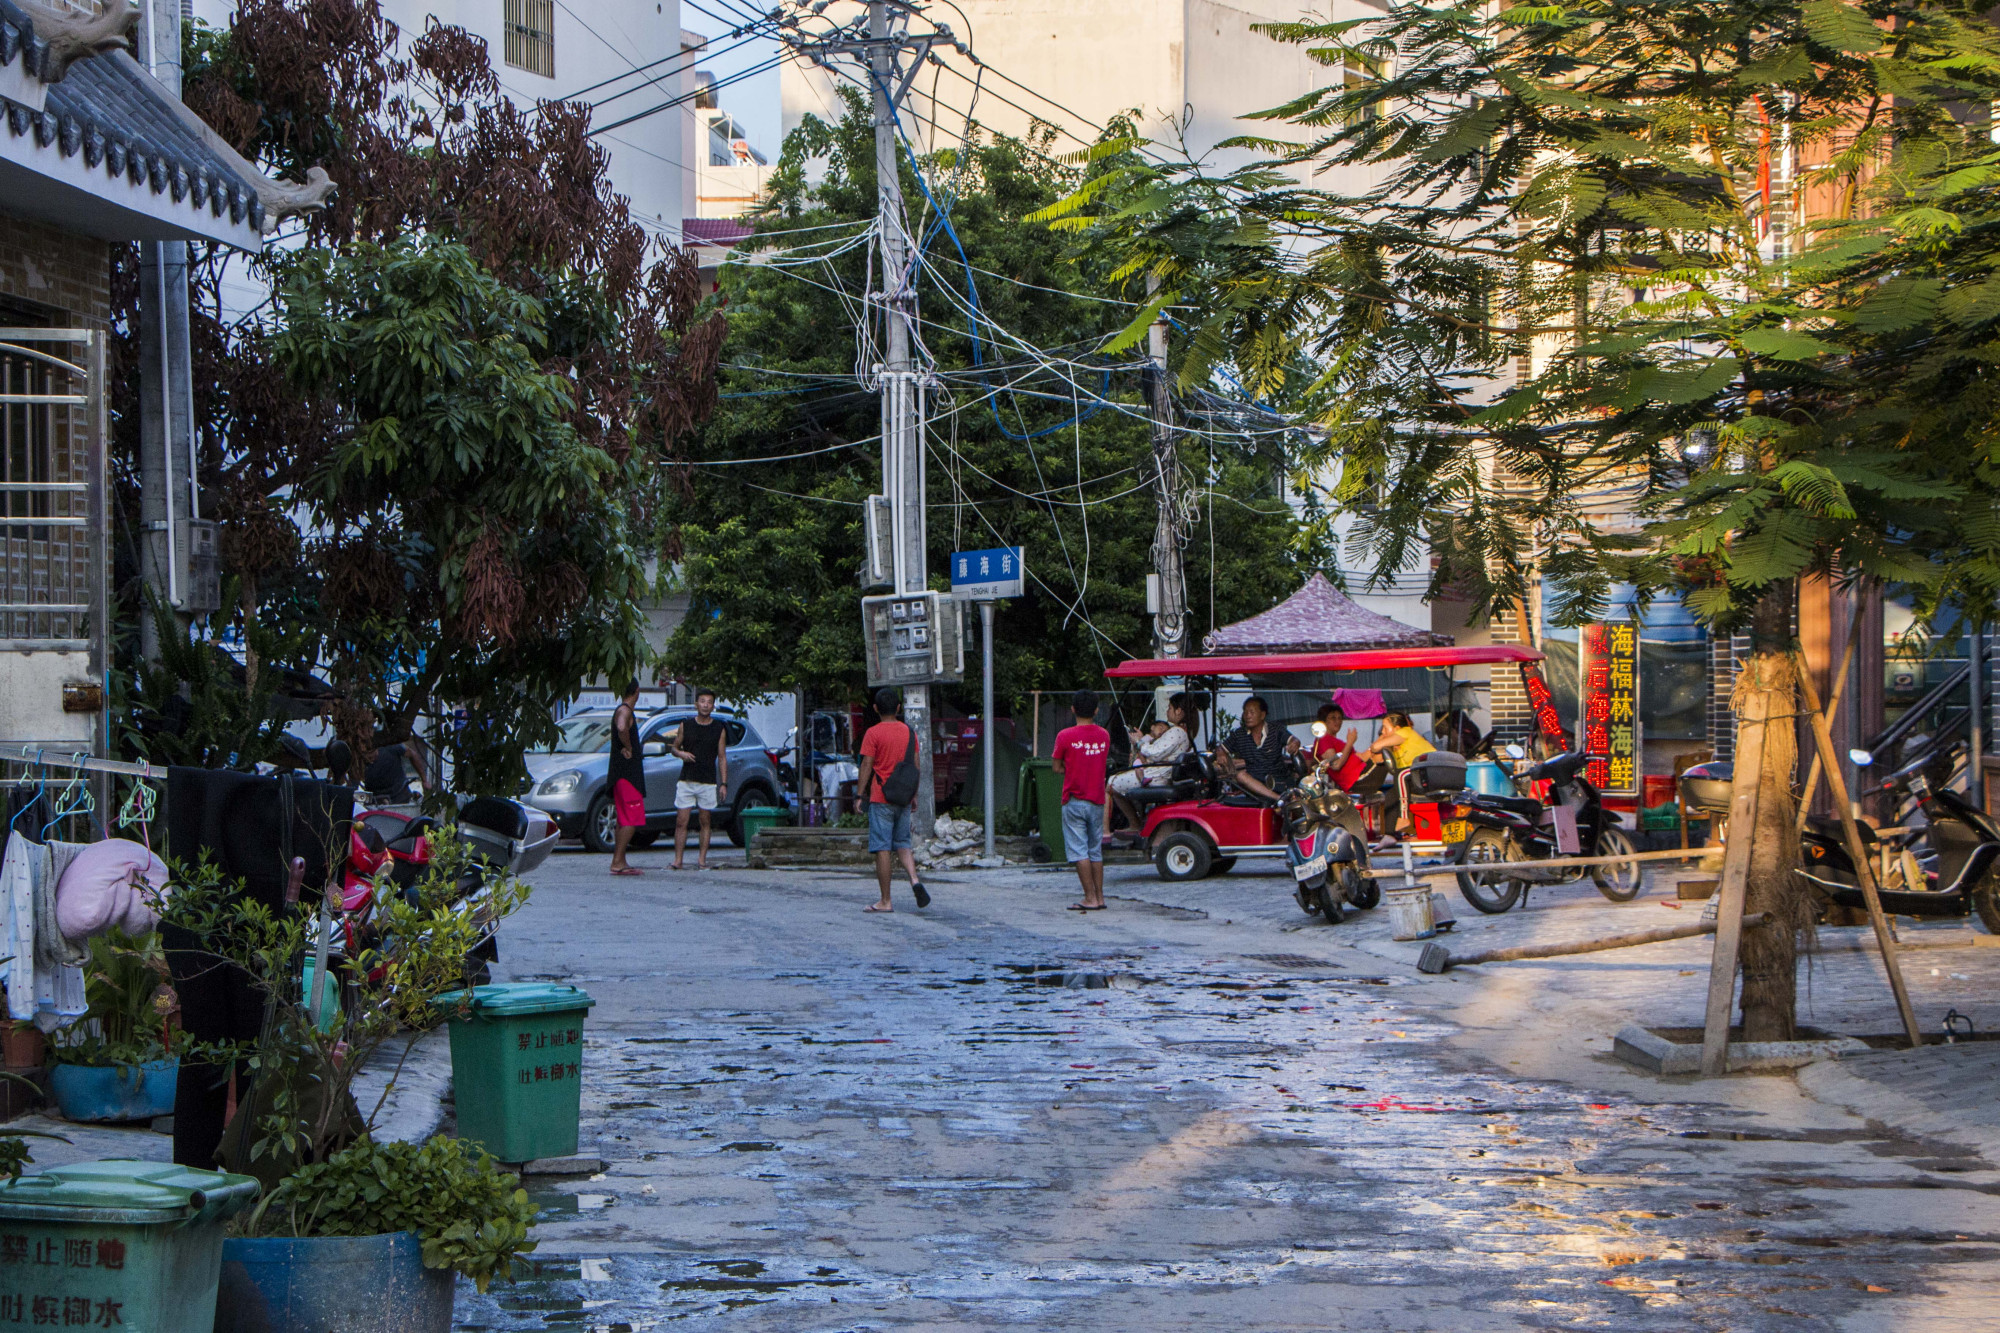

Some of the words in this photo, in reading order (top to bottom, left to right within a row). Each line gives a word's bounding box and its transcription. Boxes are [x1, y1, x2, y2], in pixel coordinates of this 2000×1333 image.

[958, 554, 1011, 578] 藤海街
[971, 586, 989, 596] TENGHAI
[1610, 624, 1634, 789] 海福林海鲜
[518, 1028, 579, 1051] 禁止随地
[0, 1234, 126, 1270] 禁止随地
[1, 1293, 123, 1328] 吐槟榔水
